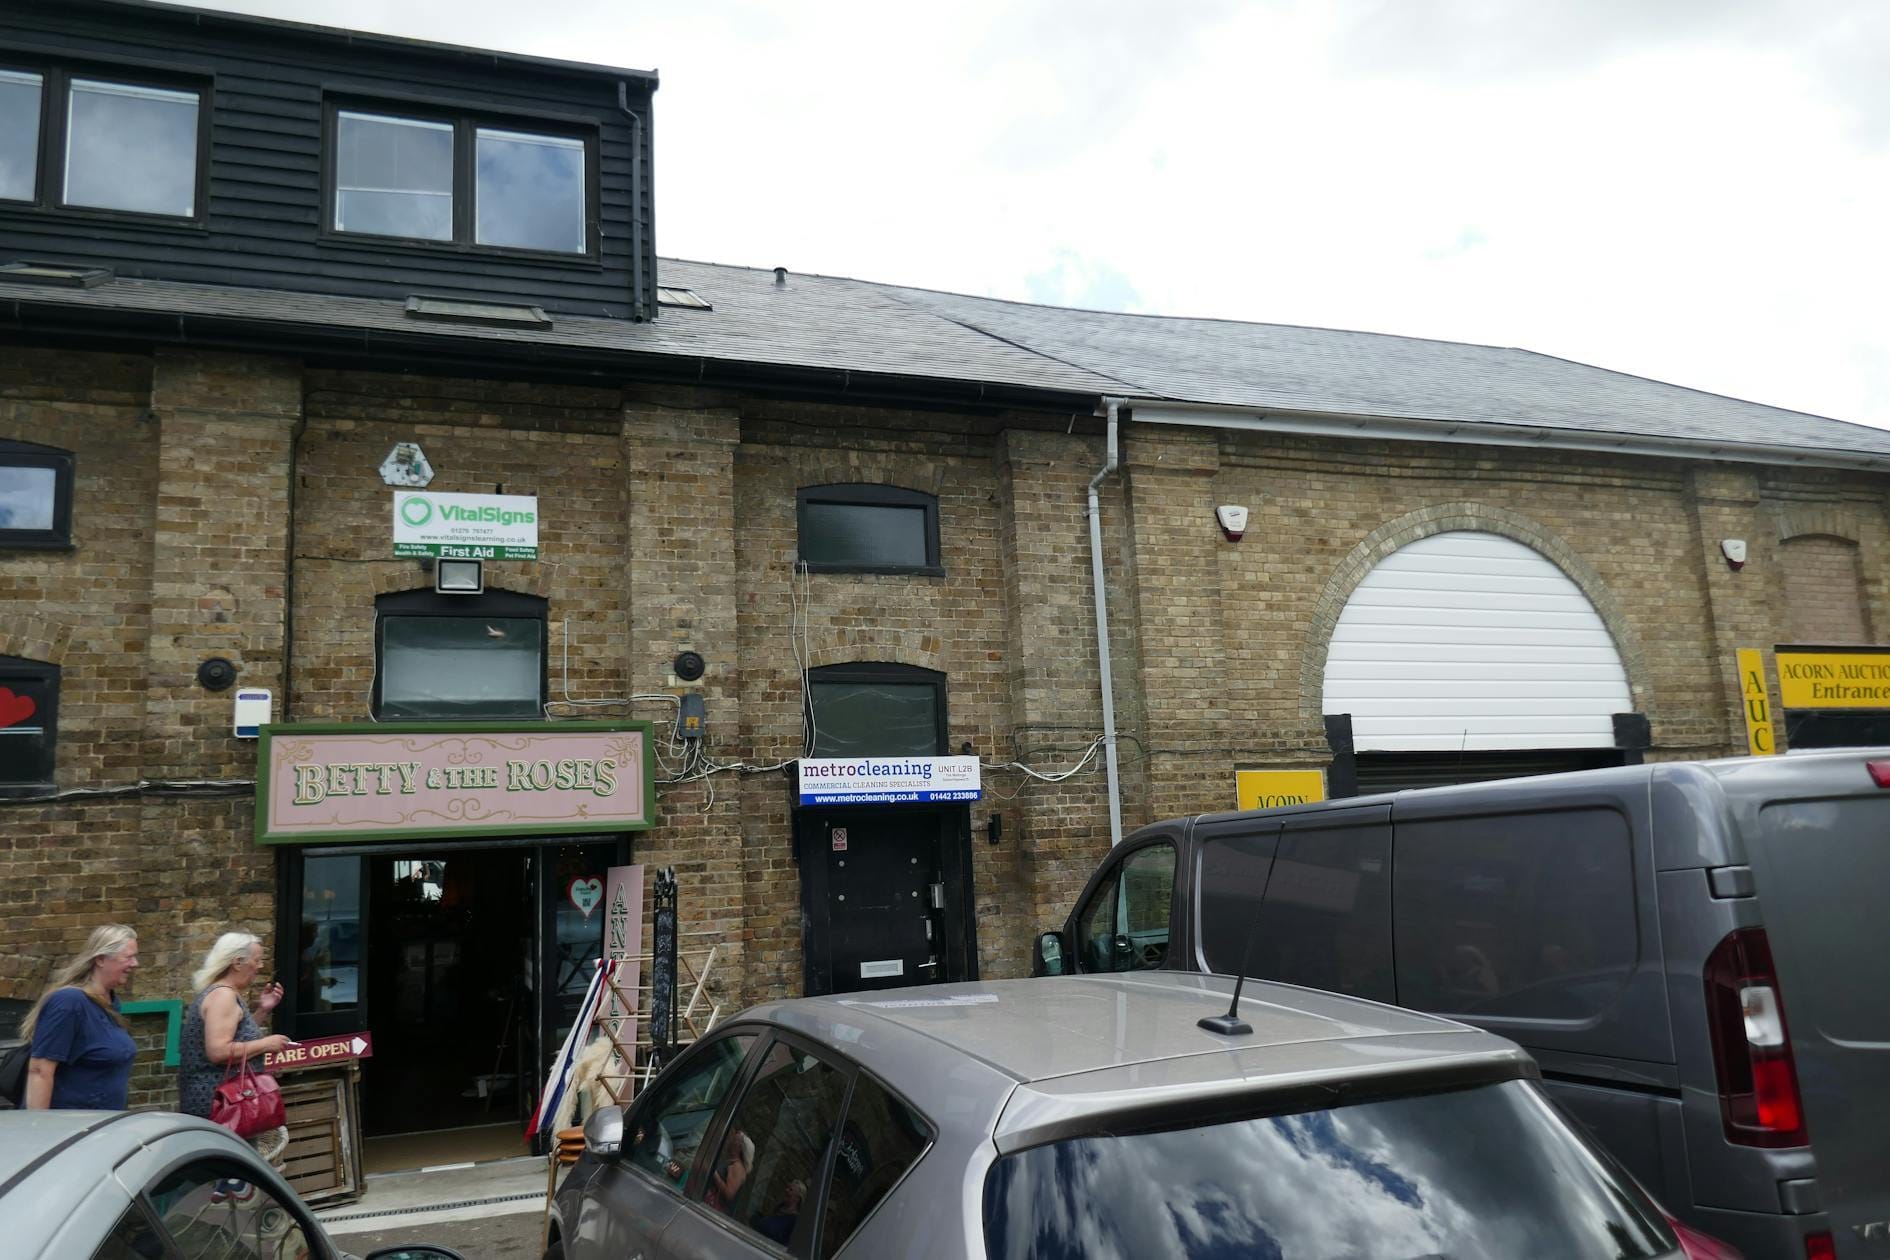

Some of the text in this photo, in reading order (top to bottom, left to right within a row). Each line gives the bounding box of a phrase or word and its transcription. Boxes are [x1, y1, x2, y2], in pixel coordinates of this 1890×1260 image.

[438, 503, 535, 526] VitalSigns
[440, 545, 495, 558] First Aid
[1782, 663, 1835, 680] ACORN
[1812, 682, 1890, 700] Entrance
[803, 759, 932, 780] metrocleaning
[937, 765, 957, 774] UNIT
[293, 758, 618, 806] BETTY & THE ROSES
[803, 780, 931, 790] COMMERCIAL CLEANING SPECIALISTS
[815, 791, 919, 804] www.metrocleaning.co.uk
[930, 792, 952, 801] 01442
[275, 1047, 307, 1064] ARE
[310, 1041, 351, 1058] OPEN
